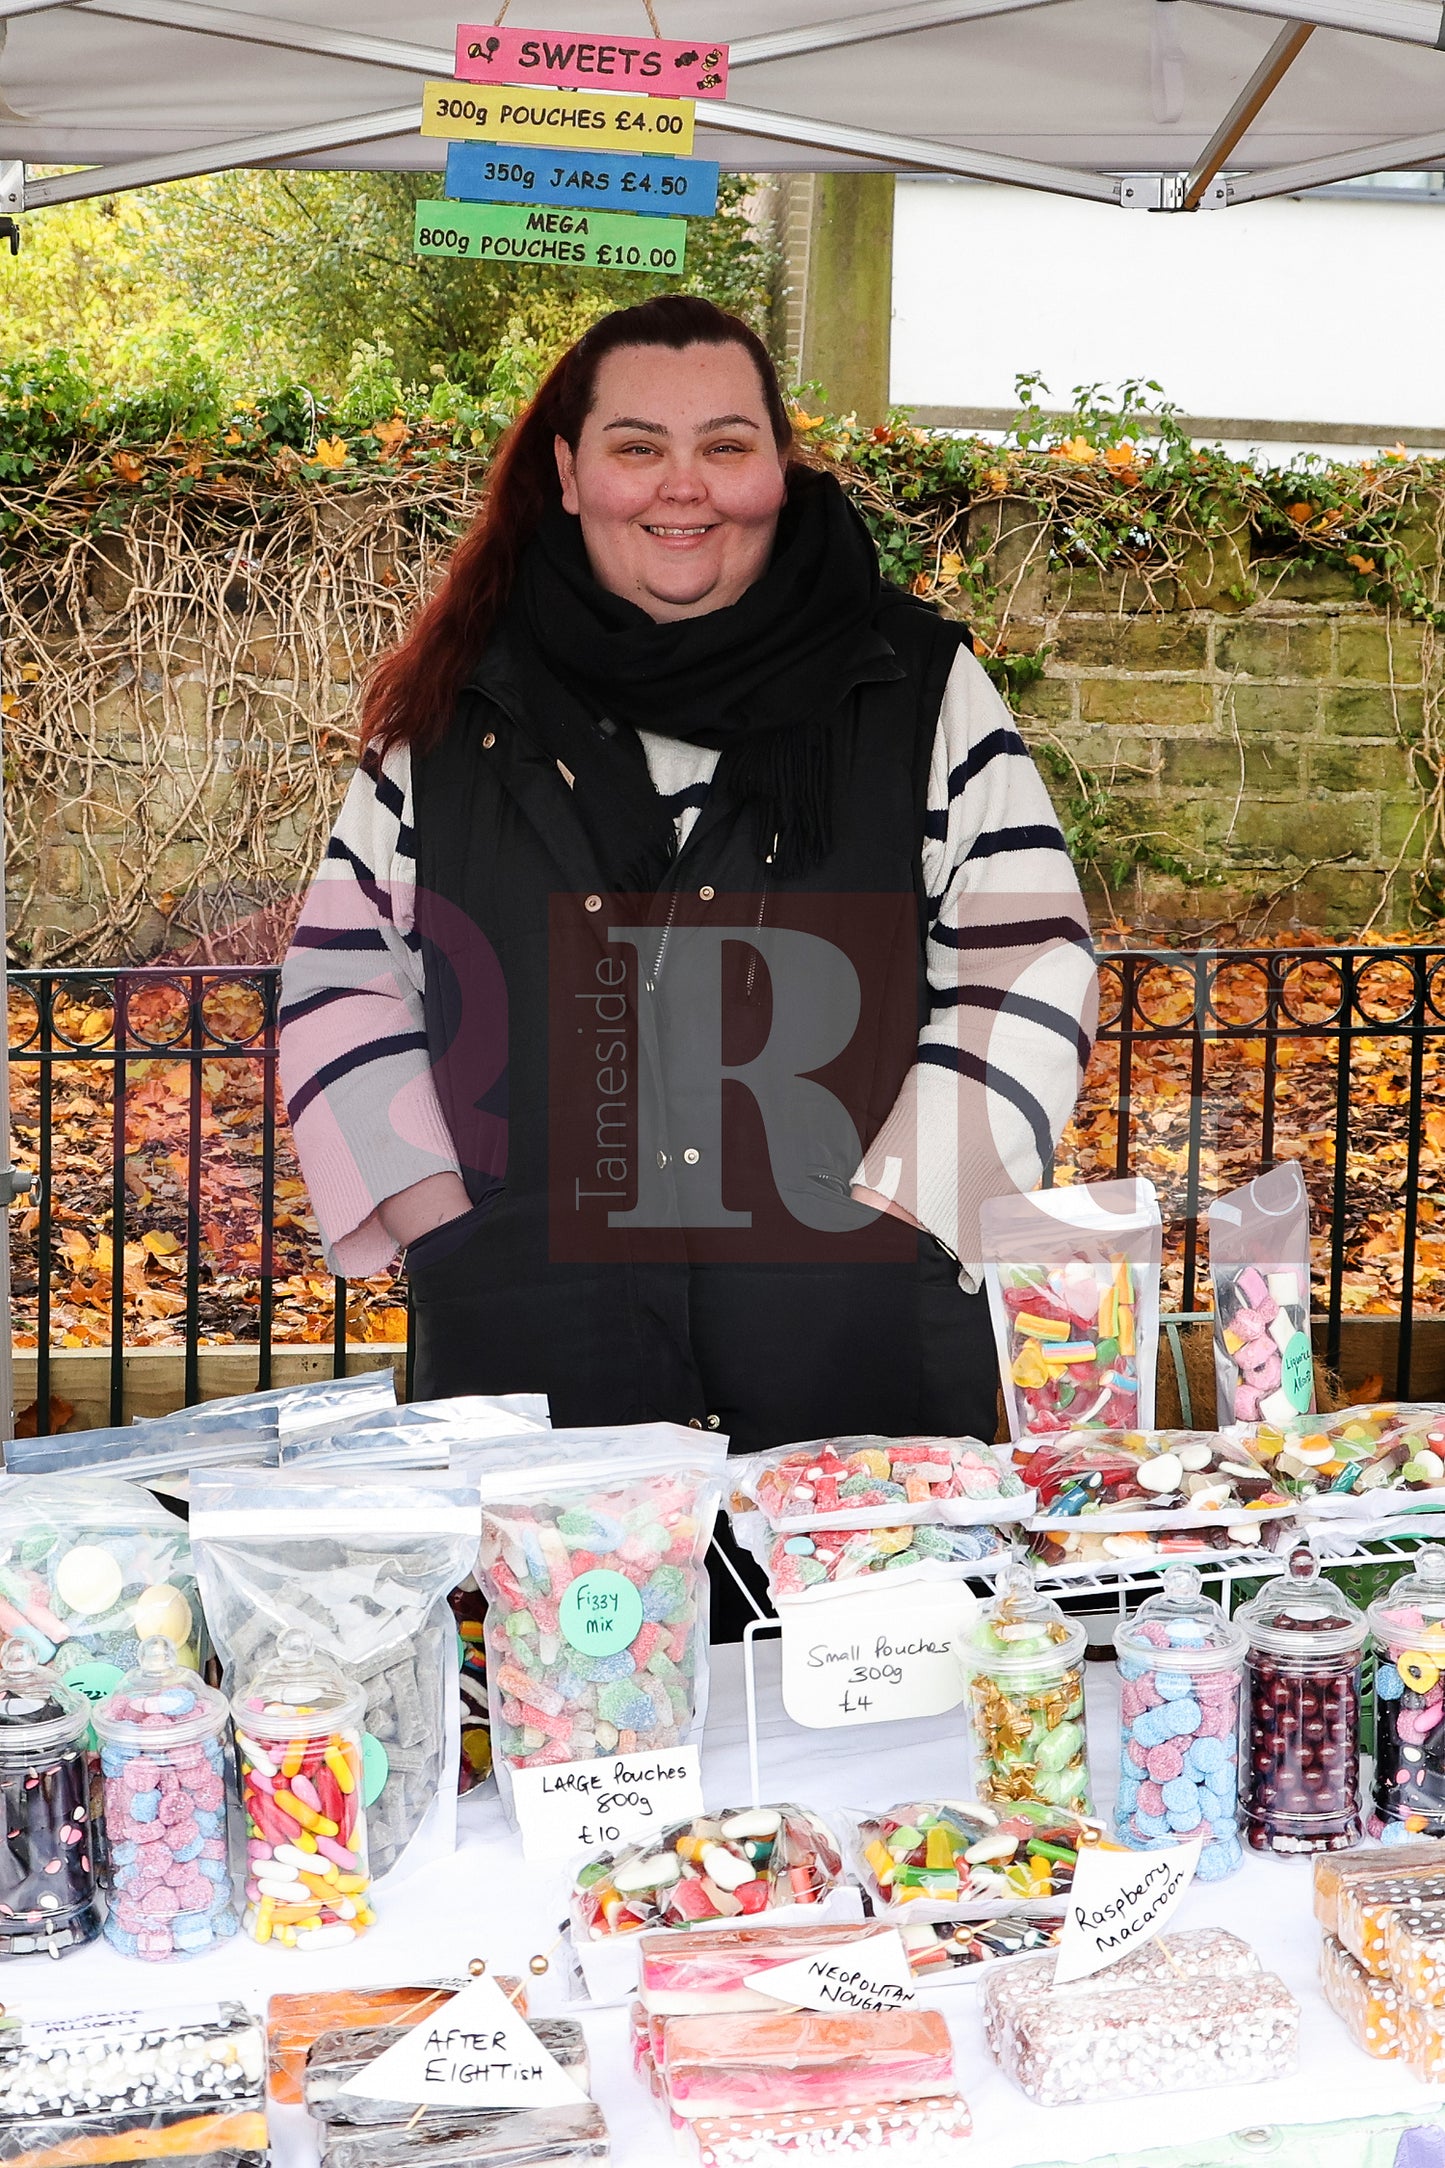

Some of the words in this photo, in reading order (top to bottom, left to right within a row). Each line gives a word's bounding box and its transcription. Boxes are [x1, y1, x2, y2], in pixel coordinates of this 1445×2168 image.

[518, 42, 662, 77] SWEETS
[436, 99, 488, 125] 300g
[500, 105, 606, 129] POUCHES
[615, 111, 683, 134] £4.00
[484, 163, 535, 189] 350g
[550, 168, 610, 191] JARS
[621, 171, 688, 196] £4.50
[526, 212, 589, 235] MEGA
[419, 229, 470, 254] 800g
[481, 236, 586, 262] POUCHES
[596, 245, 677, 268] £10.00
[577, 1584, 618, 1612] Fizzy
[586, 1616, 614, 1634] mix
[807, 1644, 860, 1668] Small
[875, 1635, 951, 1659] Pouches
[848, 1664, 903, 1685] 300g
[838, 1690, 874, 1713] £4
[543, 1773, 603, 1796] LARGE
[614, 1761, 687, 1785] Pouches
[597, 1792, 653, 1816] 800g
[578, 1825, 620, 1844] £10
[1075, 1862, 1170, 1932] Raspberry
[1096, 1870, 1184, 1952] Macaroon
[808, 1961, 915, 2001] NEOPOLITAN
[424, 2029, 507, 2053] AFTER
